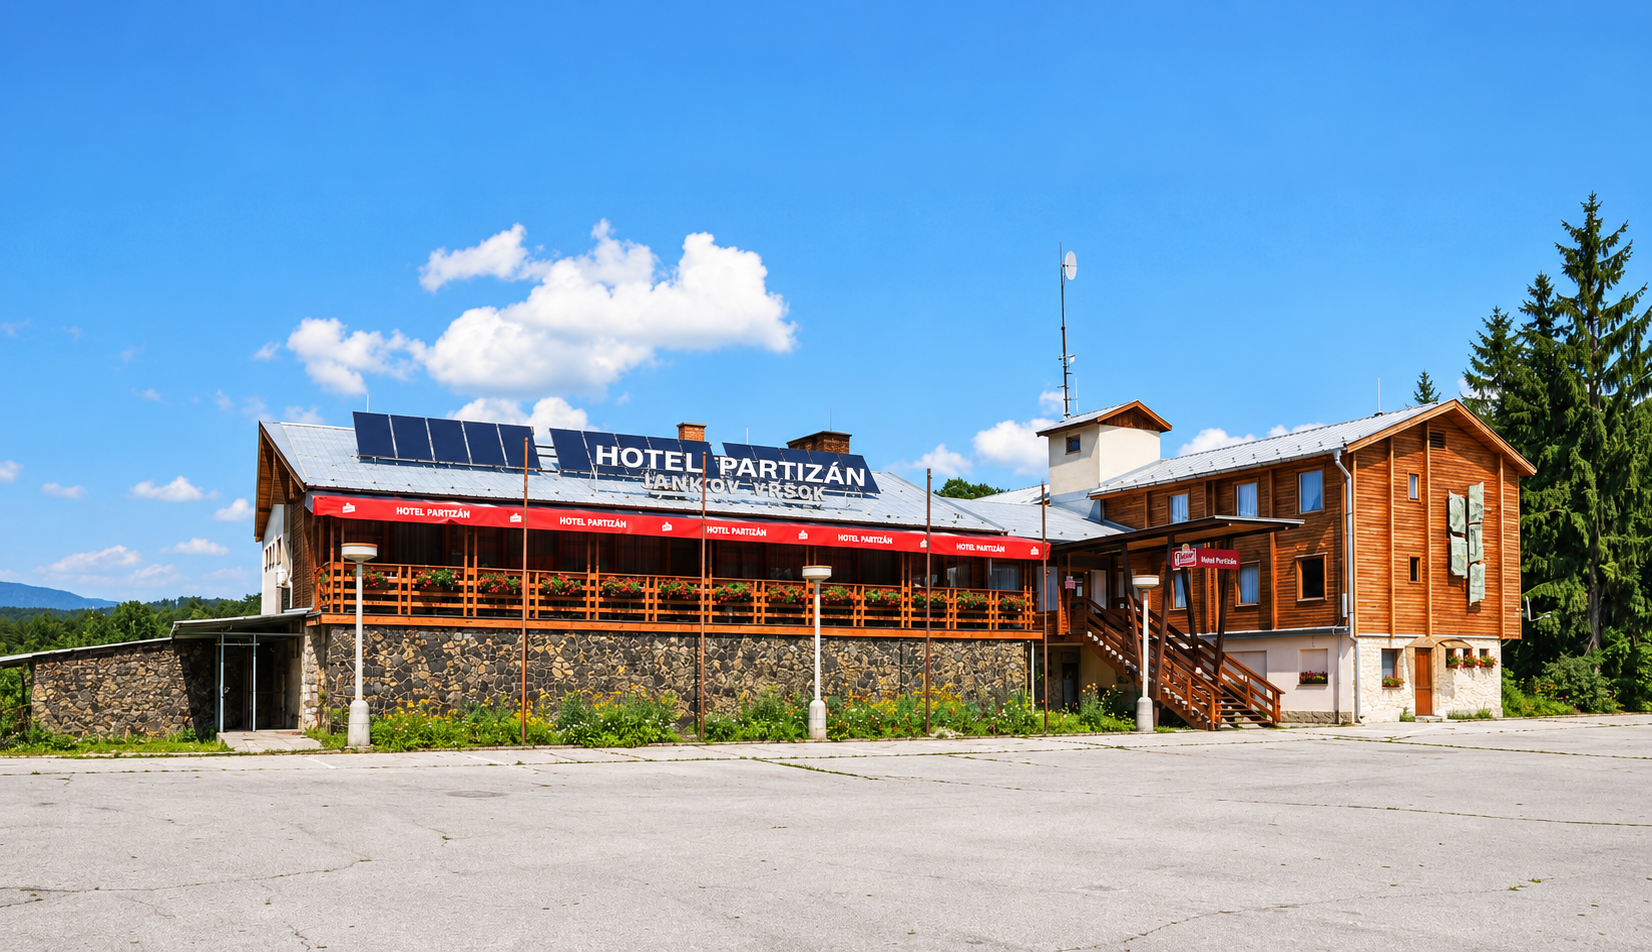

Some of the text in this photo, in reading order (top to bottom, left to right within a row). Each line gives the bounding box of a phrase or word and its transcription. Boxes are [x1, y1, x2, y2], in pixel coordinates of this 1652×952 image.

[595, 444, 865, 487] HOTEL PARTIZÁN
[396, 506, 470, 519] HOTEL PARTIZÁN
[559, 516, 627, 528] HOTEL PARTIZÁN
[706, 526, 767, 537] HOTEL PARTIZÁN
[838, 534, 893, 545] HOTEL PARTIZÁN
[956, 543, 975, 551] HOTEL
